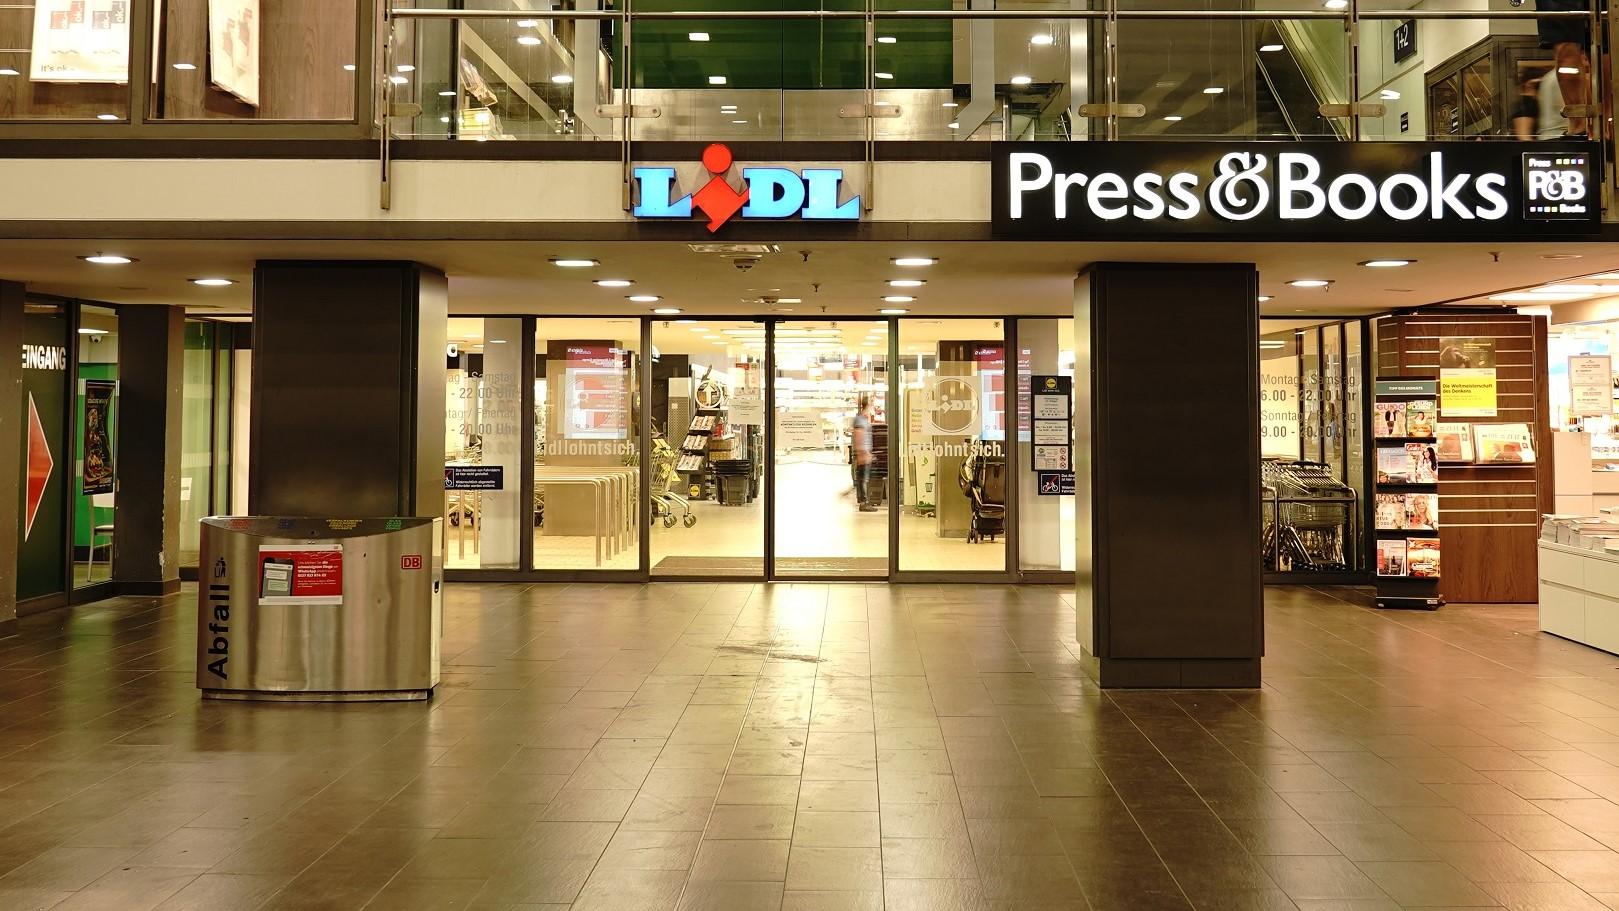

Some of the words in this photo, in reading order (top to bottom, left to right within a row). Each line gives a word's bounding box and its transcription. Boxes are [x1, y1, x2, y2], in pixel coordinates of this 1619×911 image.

[1396, 24, 1409, 50] 1+2
[1529, 158, 1552, 167] Press
[1559, 203, 1586, 213] Books
[22, 344, 66, 370] EINGANG
[1261, 374, 1300, 388] Montag
[1261, 389, 1287, 401] 6.00
[1300, 389, 1332, 401] 22.00
[1261, 410, 1303, 423] Sonntag
[1261, 426, 1287, 438] 9.00
[402, 556, 421, 568] DB
[208, 584, 230, 680] Abfall
